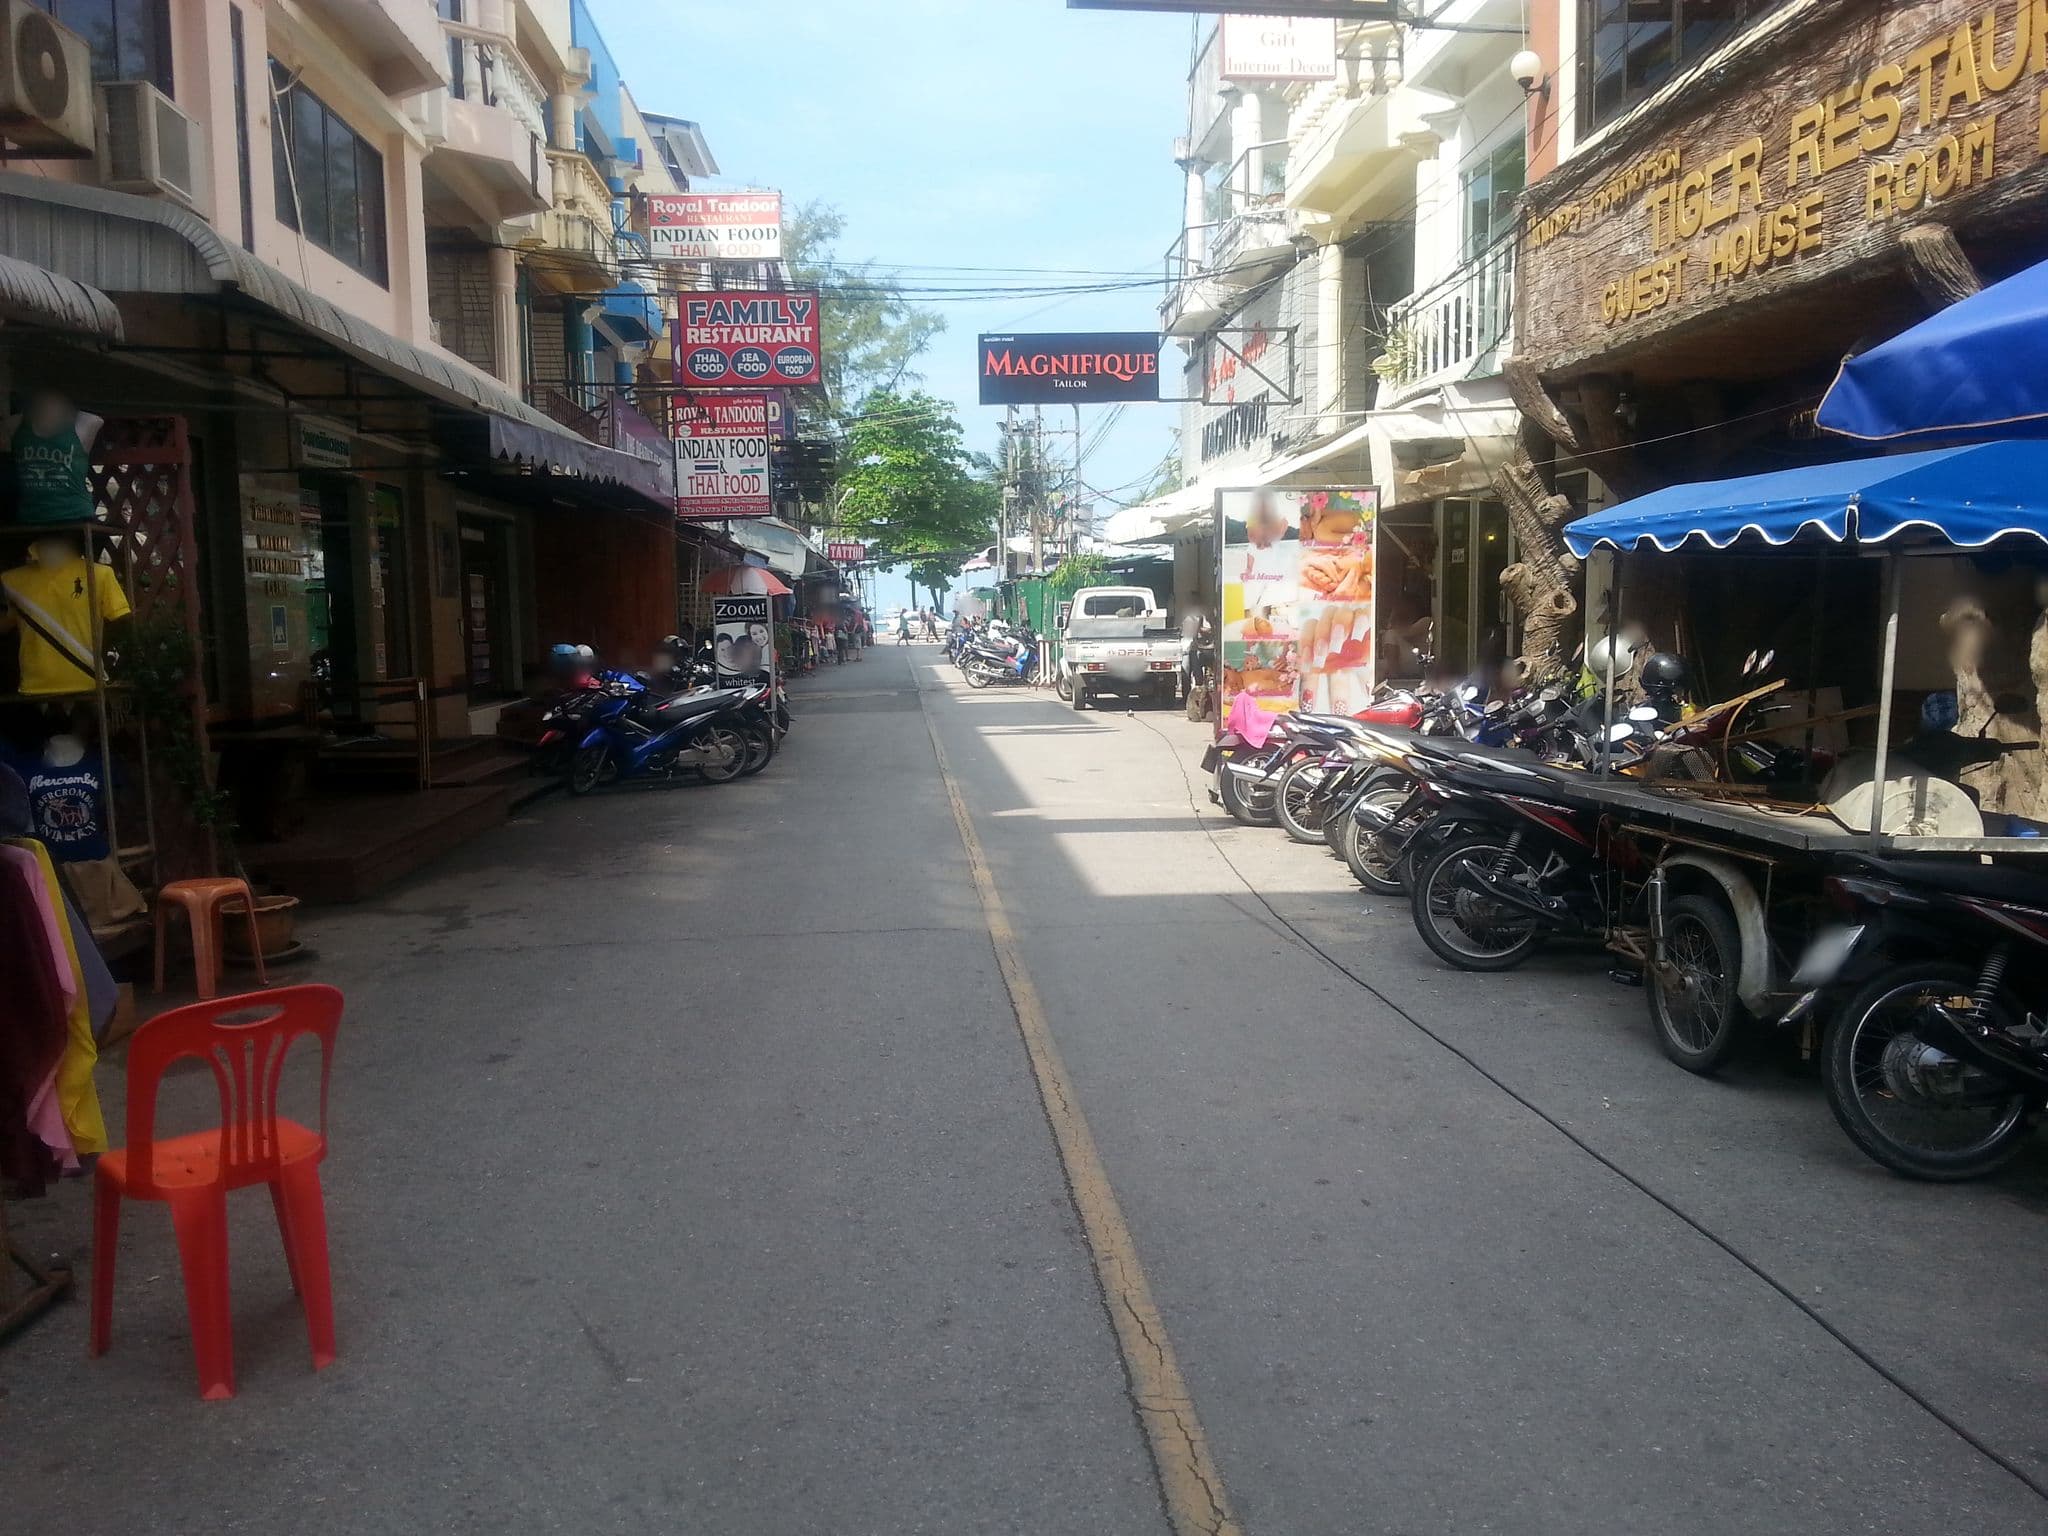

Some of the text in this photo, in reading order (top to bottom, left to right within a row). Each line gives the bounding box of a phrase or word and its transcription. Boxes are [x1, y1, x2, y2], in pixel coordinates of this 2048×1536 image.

[1260, 32, 1295, 47] Gift
[1228, 57, 1331, 73] Interior Decor
[1644, 135, 1764, 254] TIGER
[652, 198, 779, 216] Royal Tandoor
[687, 215, 752, 223] RESTAURANT
[1600, 251, 1688, 327] GUEST
[1706, 192, 1828, 285] HOUSE
[1865, 111, 2000, 223] ROOM
[653, 227, 778, 242] INDIAN FOOD
[670, 244, 762, 257] THAI FOOD
[687, 299, 812, 327] FAMILY
[687, 327, 812, 344] RESTAURANT
[695, 354, 719, 363] THAI
[742, 353, 760, 363] SEA
[777, 355, 812, 364] EUROPEAN
[695, 363, 725, 373] FOOD
[737, 363, 767, 373] FOOD
[785, 366, 804, 375] FOOD
[714, 406, 767, 423] TANDOOR
[700, 426, 767, 434] RESTAURANT
[677, 439, 726, 459] INDIAN
[729, 438, 767, 458] FOOD
[719, 460, 728, 474] &
[688, 475, 761, 495] THAI FOOD
[830, 545, 864, 559] TATTOO
[716, 603, 765, 616] ZOOM!
[1118, 649, 1153, 657] DFSK
[725, 678, 756, 686] whitest
